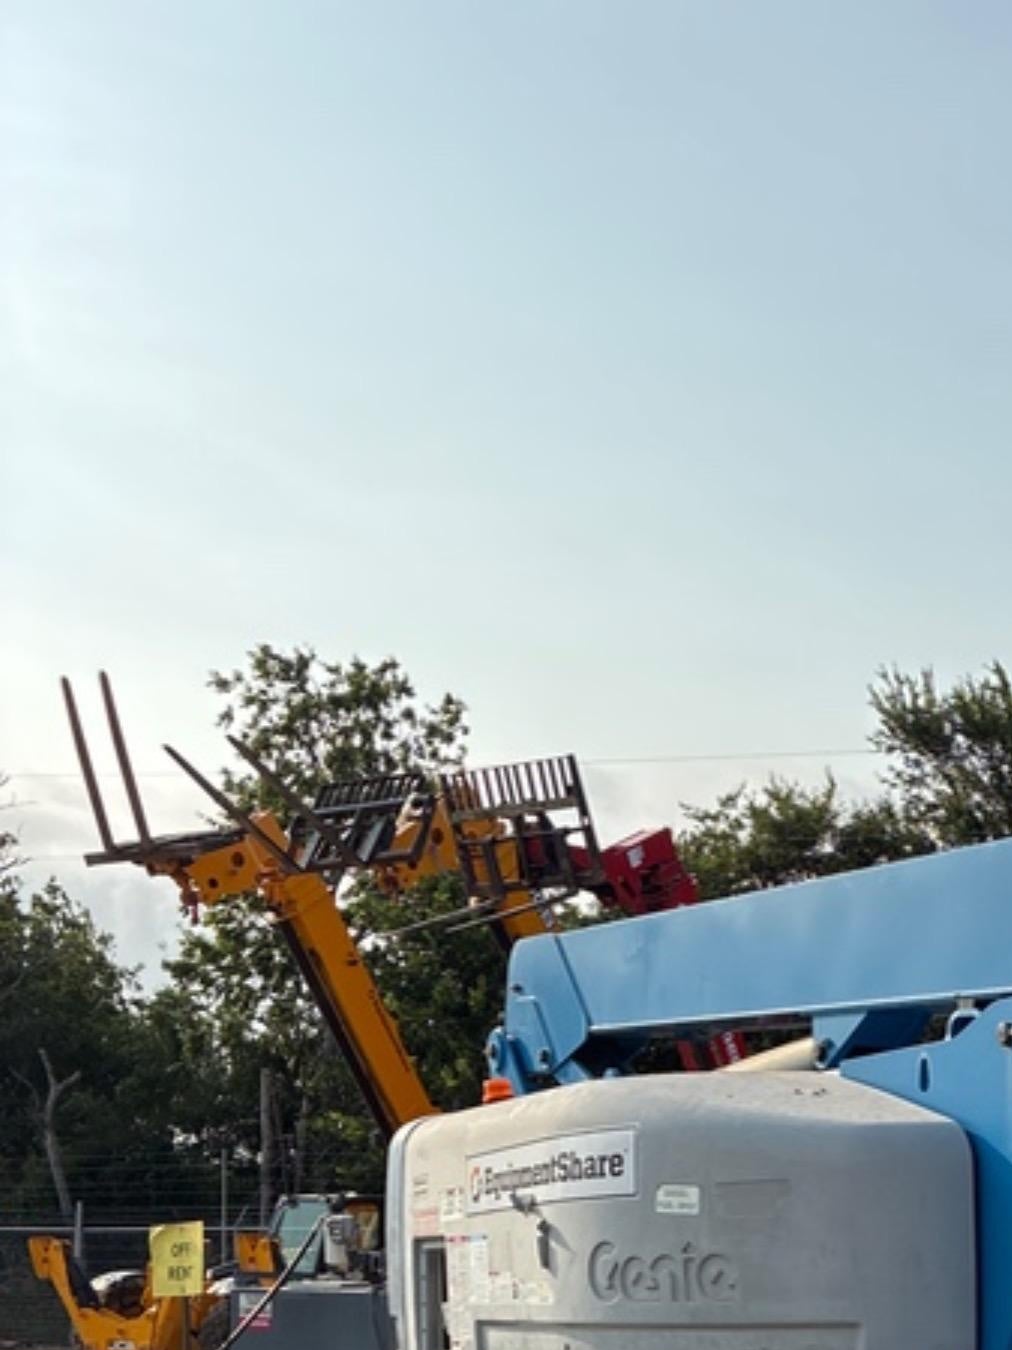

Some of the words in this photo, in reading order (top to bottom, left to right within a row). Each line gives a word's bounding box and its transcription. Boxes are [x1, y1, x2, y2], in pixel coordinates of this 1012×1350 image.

[170, 1241, 192, 1258] OFF
[167, 1265, 192, 1281] RENT
[587, 1240, 738, 1303] Genie
